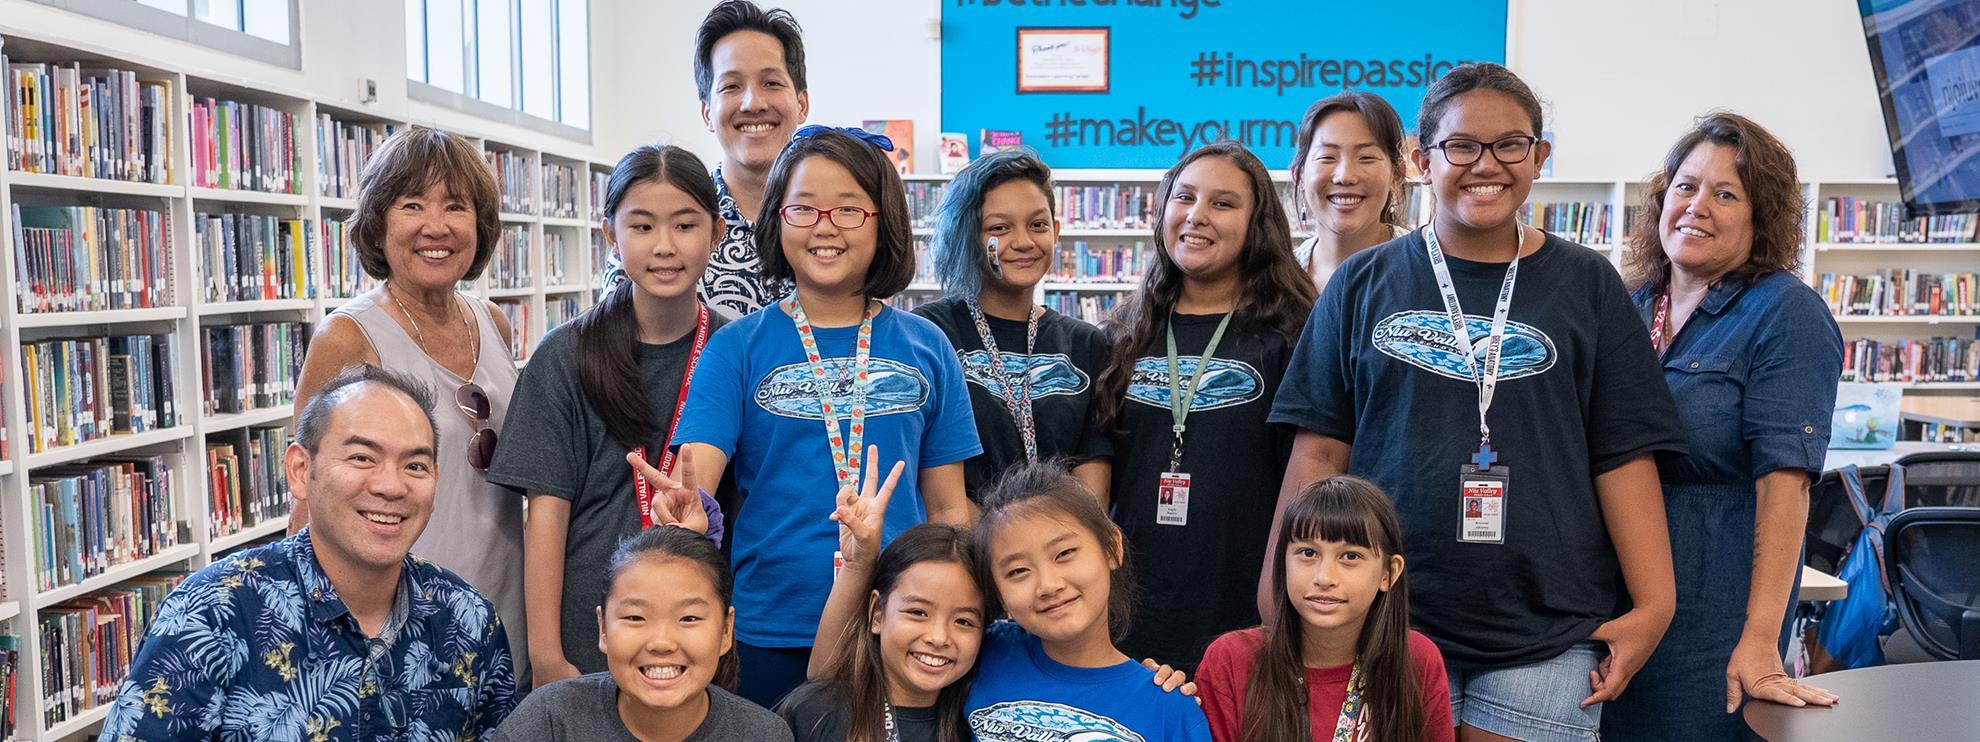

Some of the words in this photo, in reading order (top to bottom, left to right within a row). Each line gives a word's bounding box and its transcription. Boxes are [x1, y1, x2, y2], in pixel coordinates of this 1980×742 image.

[1191, 51, 1473, 98] #inspirepassio
[694, 326, 706, 355] MIDDLE
[637, 469, 648, 500] VALLE
[640, 498, 650, 516] NIU
[970, 719, 1005, 734] Niu
